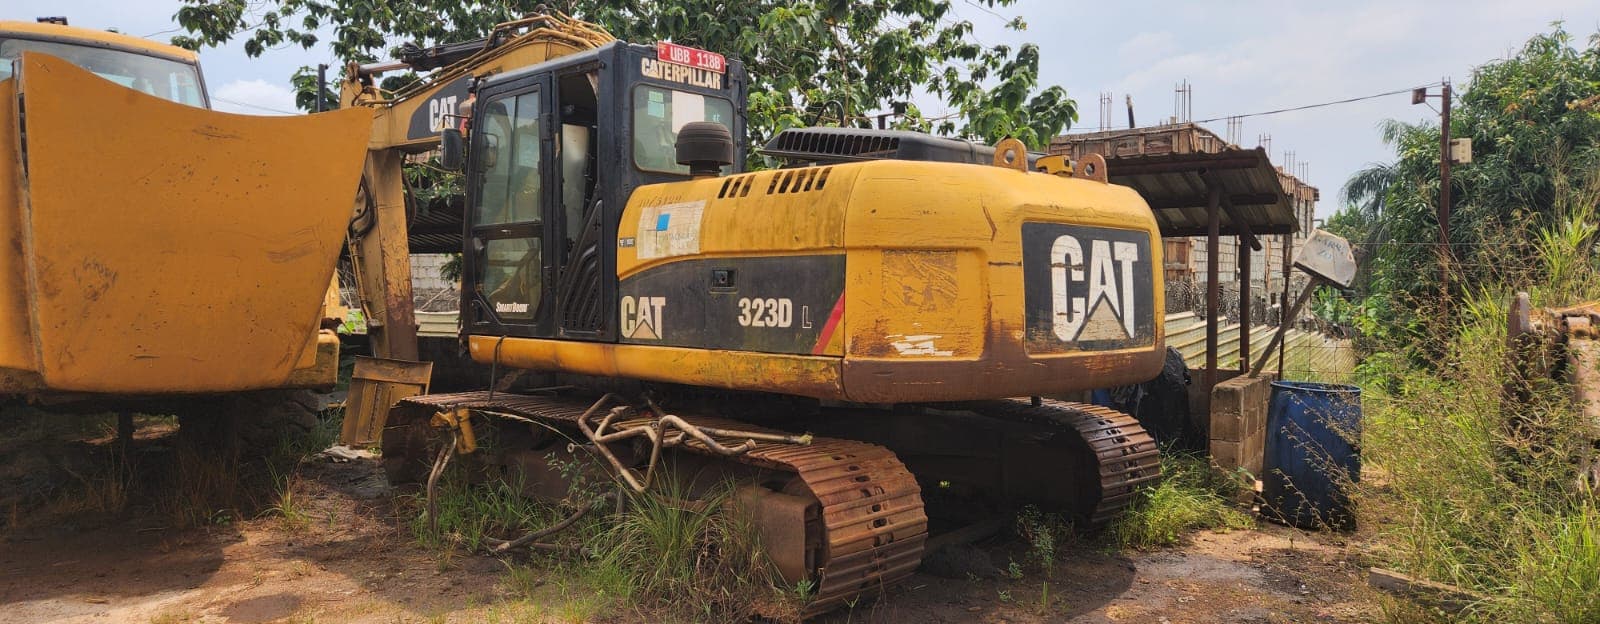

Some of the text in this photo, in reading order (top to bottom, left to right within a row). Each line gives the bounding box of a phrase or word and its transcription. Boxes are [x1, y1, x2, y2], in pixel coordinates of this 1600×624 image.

[641, 57, 721, 90] CATERPILLAR
[669, 46, 721, 70] UBB 118B
[429, 95, 457, 133] CAT
[1050, 234, 1138, 342] CAT
[620, 296, 666, 340] CAT
[738, 298, 812, 329] 323D L
